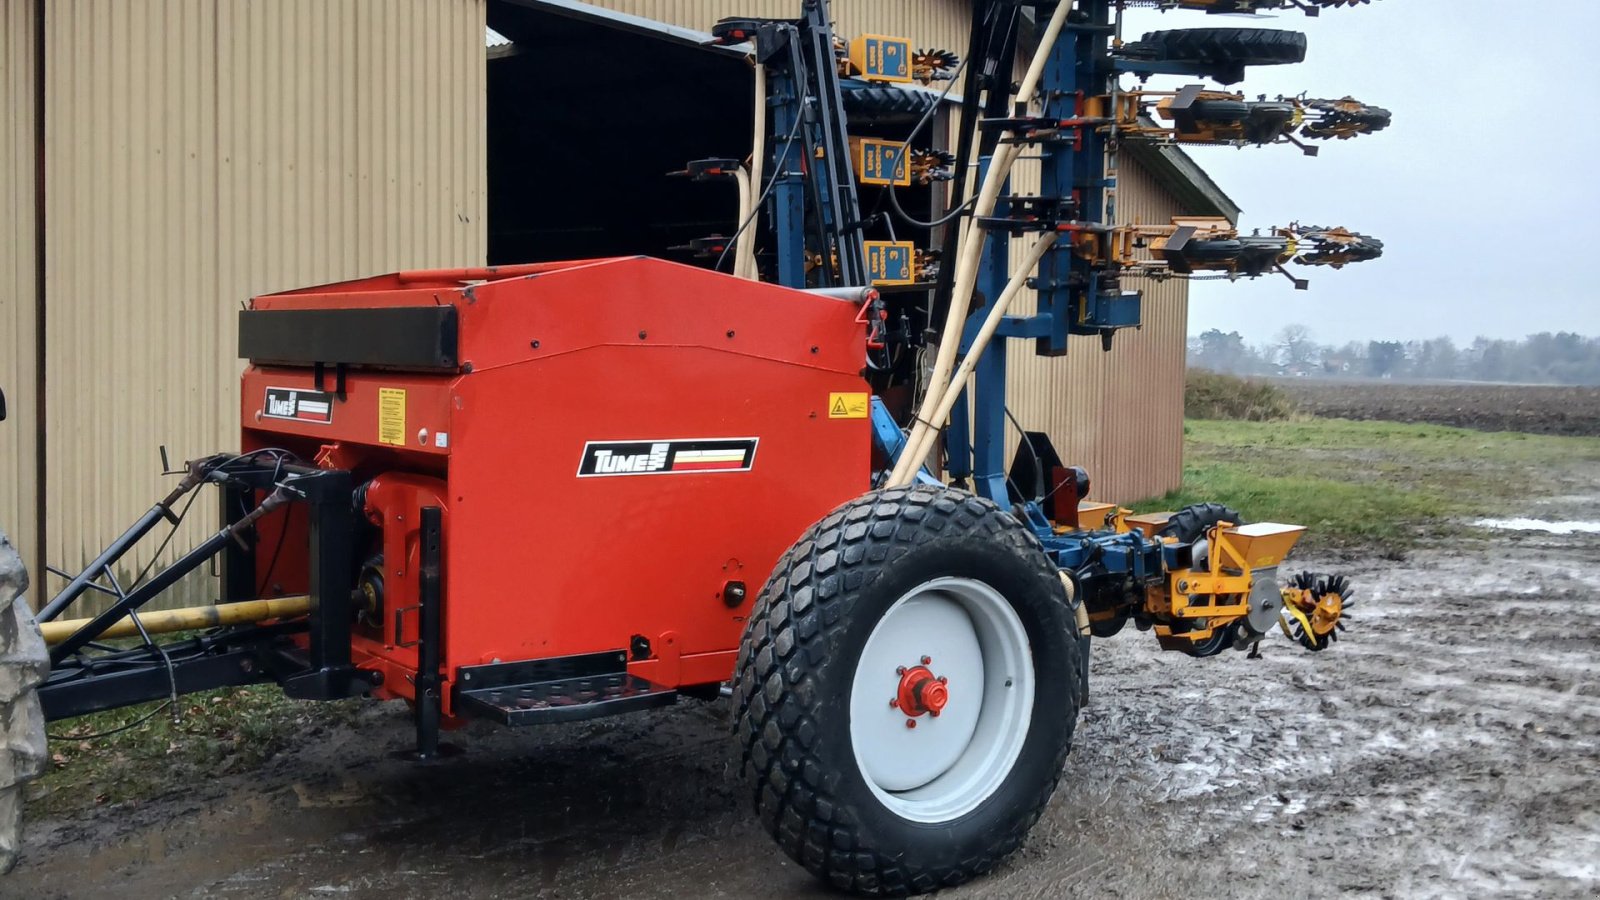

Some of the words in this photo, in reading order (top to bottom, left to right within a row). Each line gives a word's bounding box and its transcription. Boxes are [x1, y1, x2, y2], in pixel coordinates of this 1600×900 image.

[887, 45, 897, 56] 3
[885, 149, 894, 159] 3
[889, 250, 899, 260] 3
